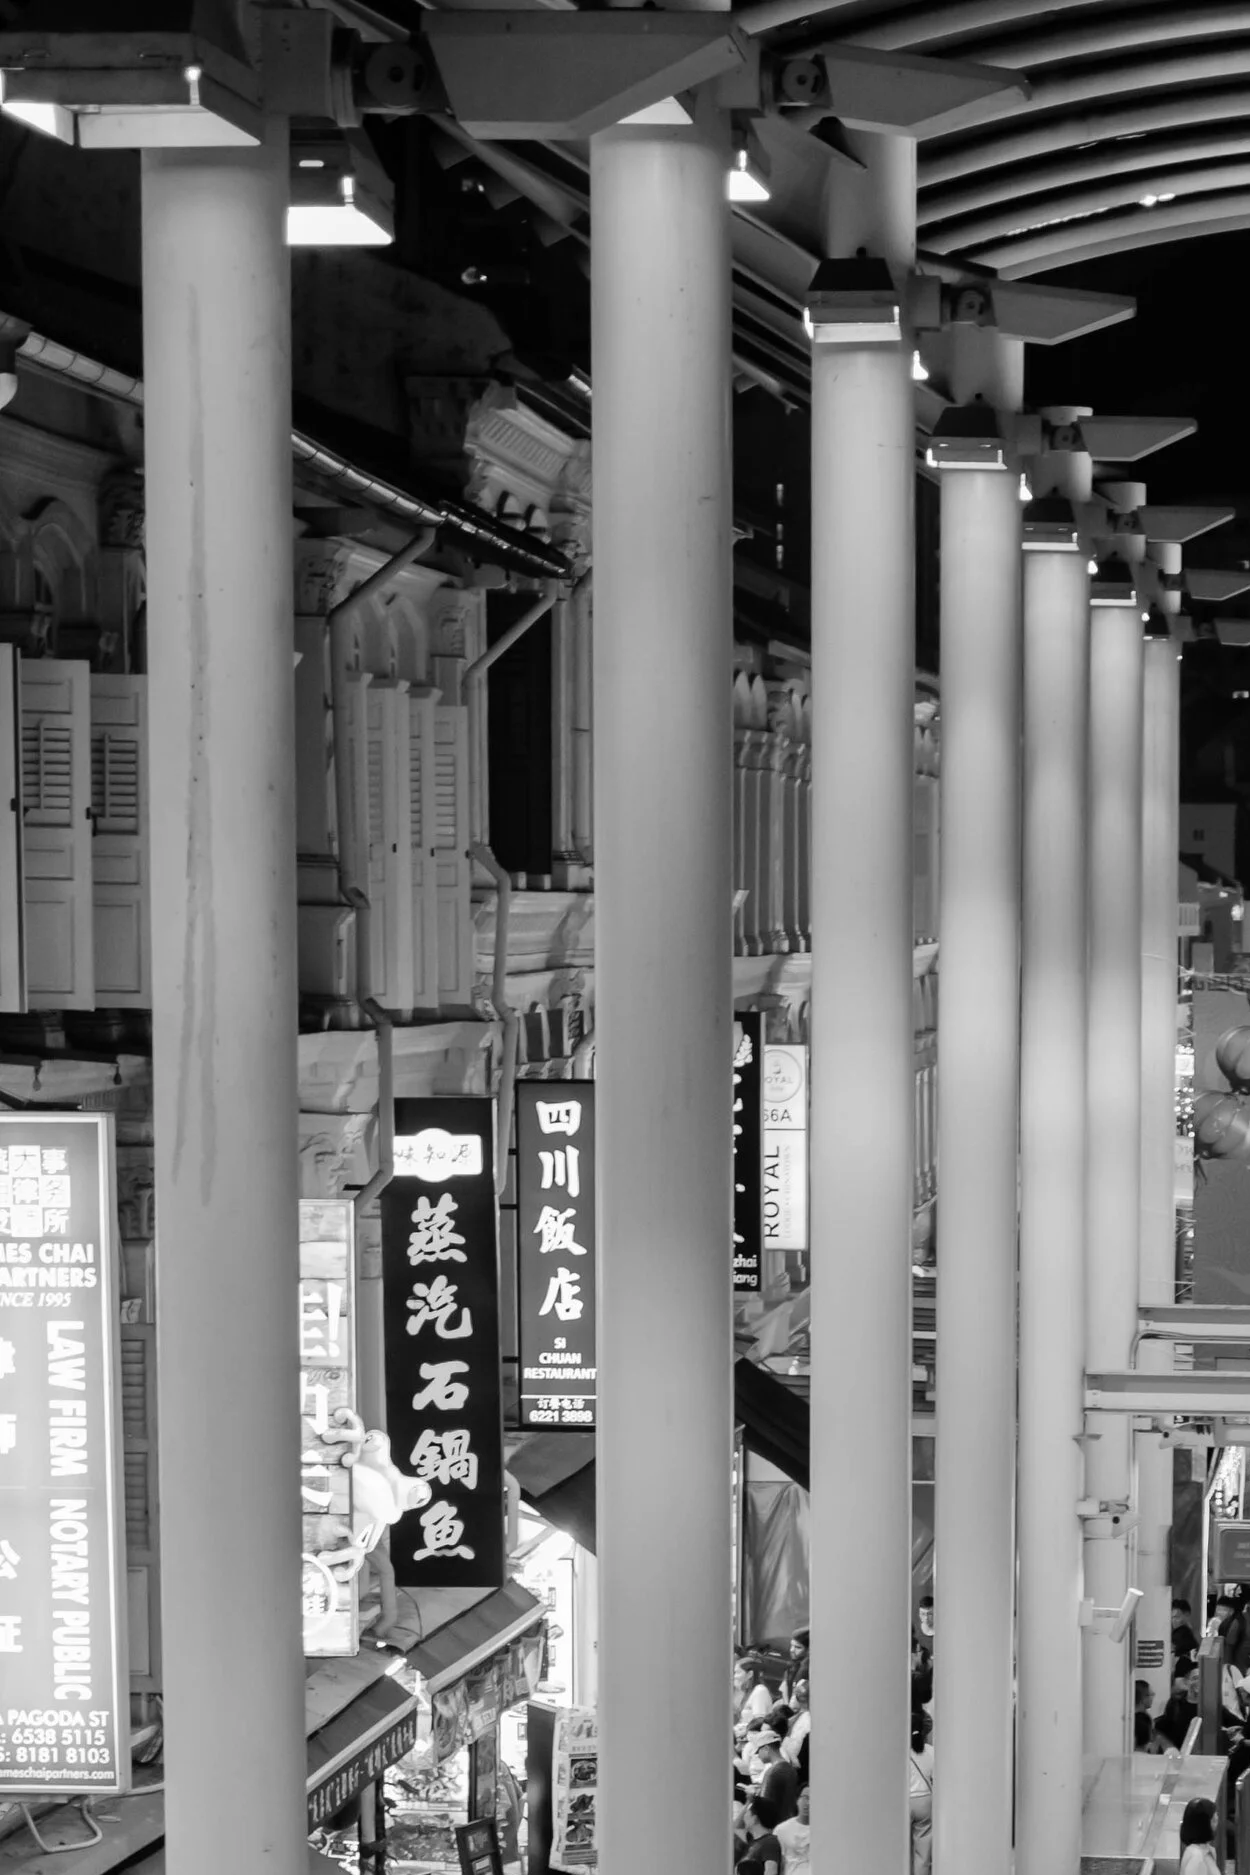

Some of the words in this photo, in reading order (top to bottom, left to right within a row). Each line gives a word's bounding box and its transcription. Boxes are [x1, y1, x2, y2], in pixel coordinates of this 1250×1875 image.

[764, 1145, 780, 1238] ROYAL
[533, 1100, 588, 1321] 四川飯店
[38, 1243, 94, 1263] CHAI
[37, 1292, 72, 1307] 1995
[554, 1336, 567, 1349] SI
[47, 1320, 87, 1391] LAW
[538, 1352, 582, 1364] CHUAN
[405, 1192, 479, 1561] 蒸汽石鍋魚
[523, 1367, 598, 1379] RESTAURANT
[529, 1410, 559, 1422] 6221
[49, 1400, 88, 1477] FIRM
[50, 1499, 90, 1605] NOTARY
[52, 1610, 92, 1700] PUBLIC
[7, 1709, 86, 1727] PAGODA
[88, 1710, 110, 1728] ST
[11, 1728, 57, 1745] 6538
[61, 1729, 106, 1745] 5115
[16, 1747, 58, 1763] 8181
[65, 1747, 111, 1764] 8103
